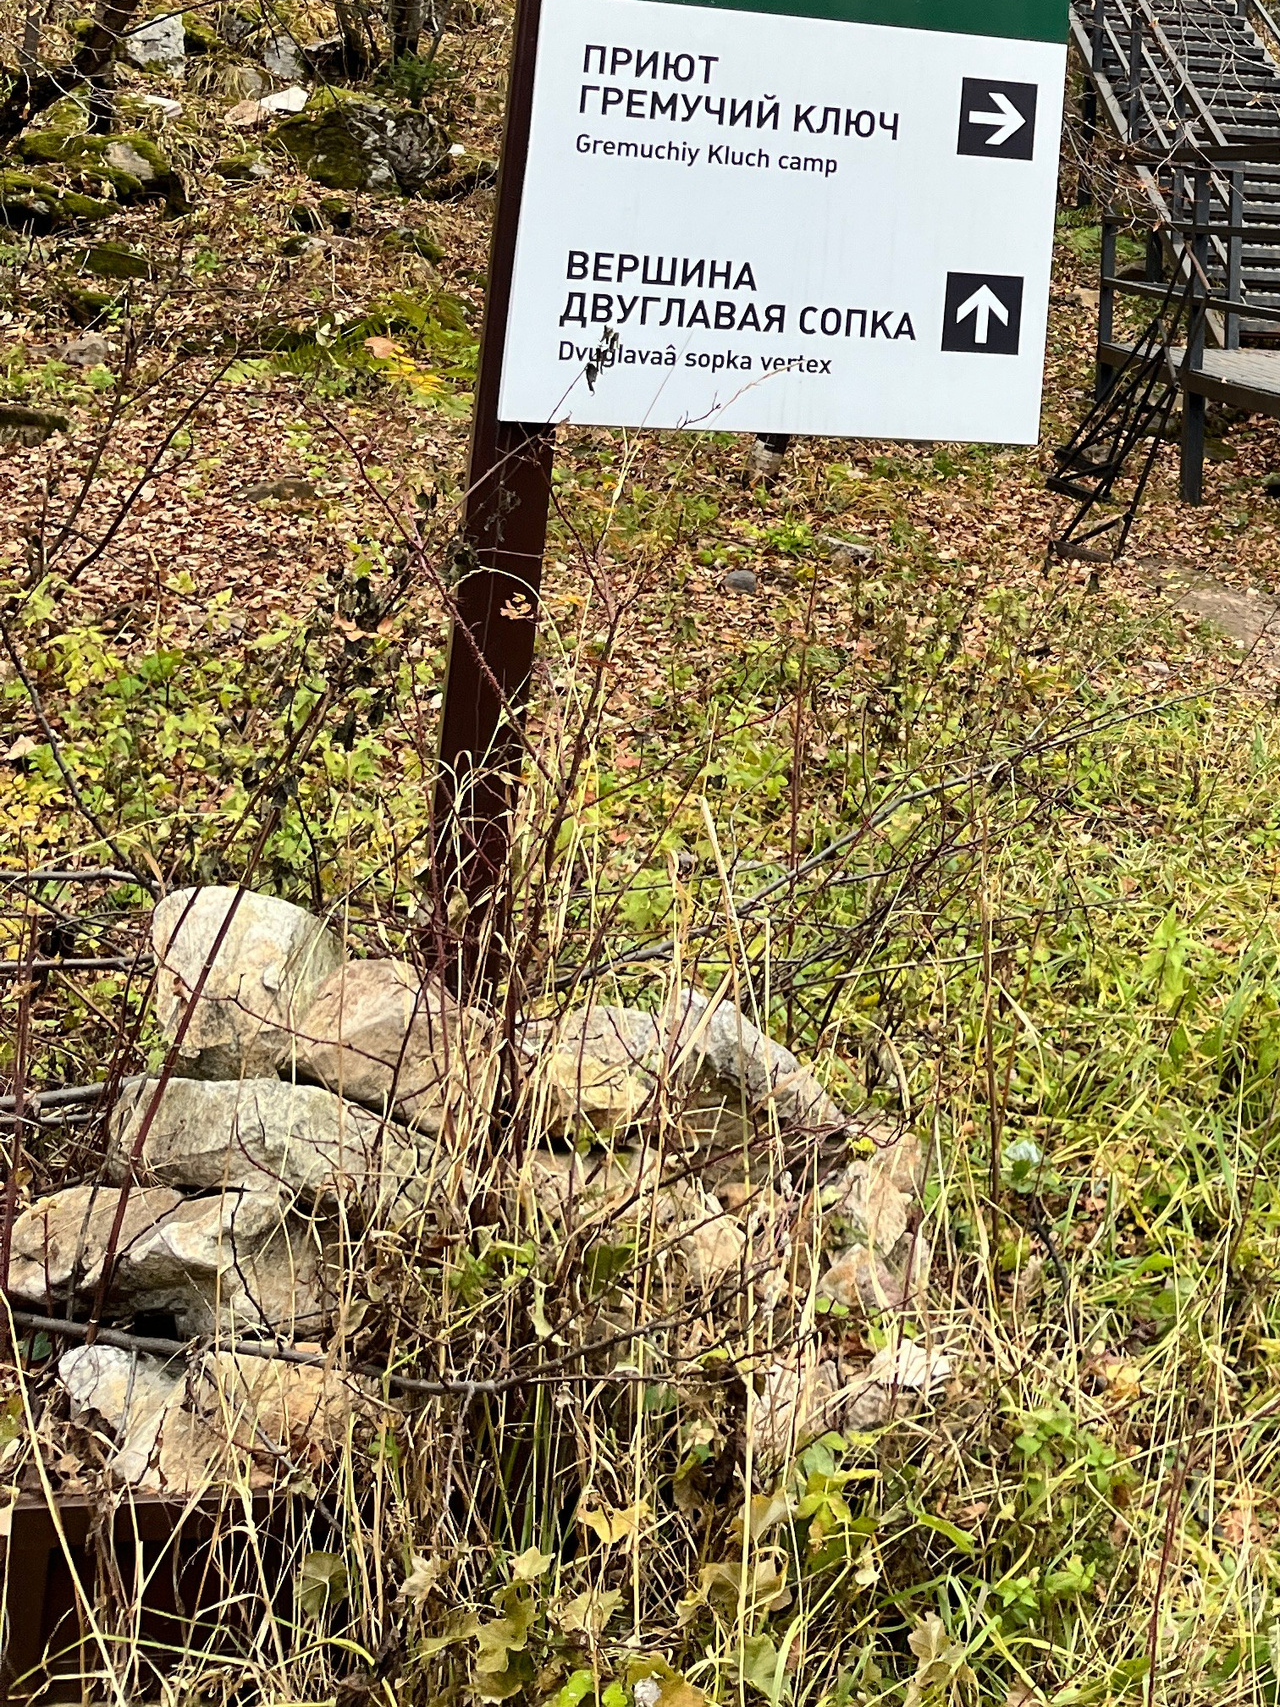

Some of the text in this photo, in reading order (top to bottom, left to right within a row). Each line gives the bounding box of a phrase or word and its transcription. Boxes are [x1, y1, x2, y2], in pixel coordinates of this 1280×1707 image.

[583, 44, 719, 84] ПРИЮТ
[579, 84, 899, 141] ГРЕМУЧИЙ КЛЮЧ
[576, 133, 838, 178] Gremuchiy Kluch camp
[566, 250, 757, 292] ВЕРШИНА
[558, 291, 916, 341] ДВУГЛАВАЯ СОПКА
[684, 349, 752, 374] sopka
[760, 354, 833, 375] vertex
